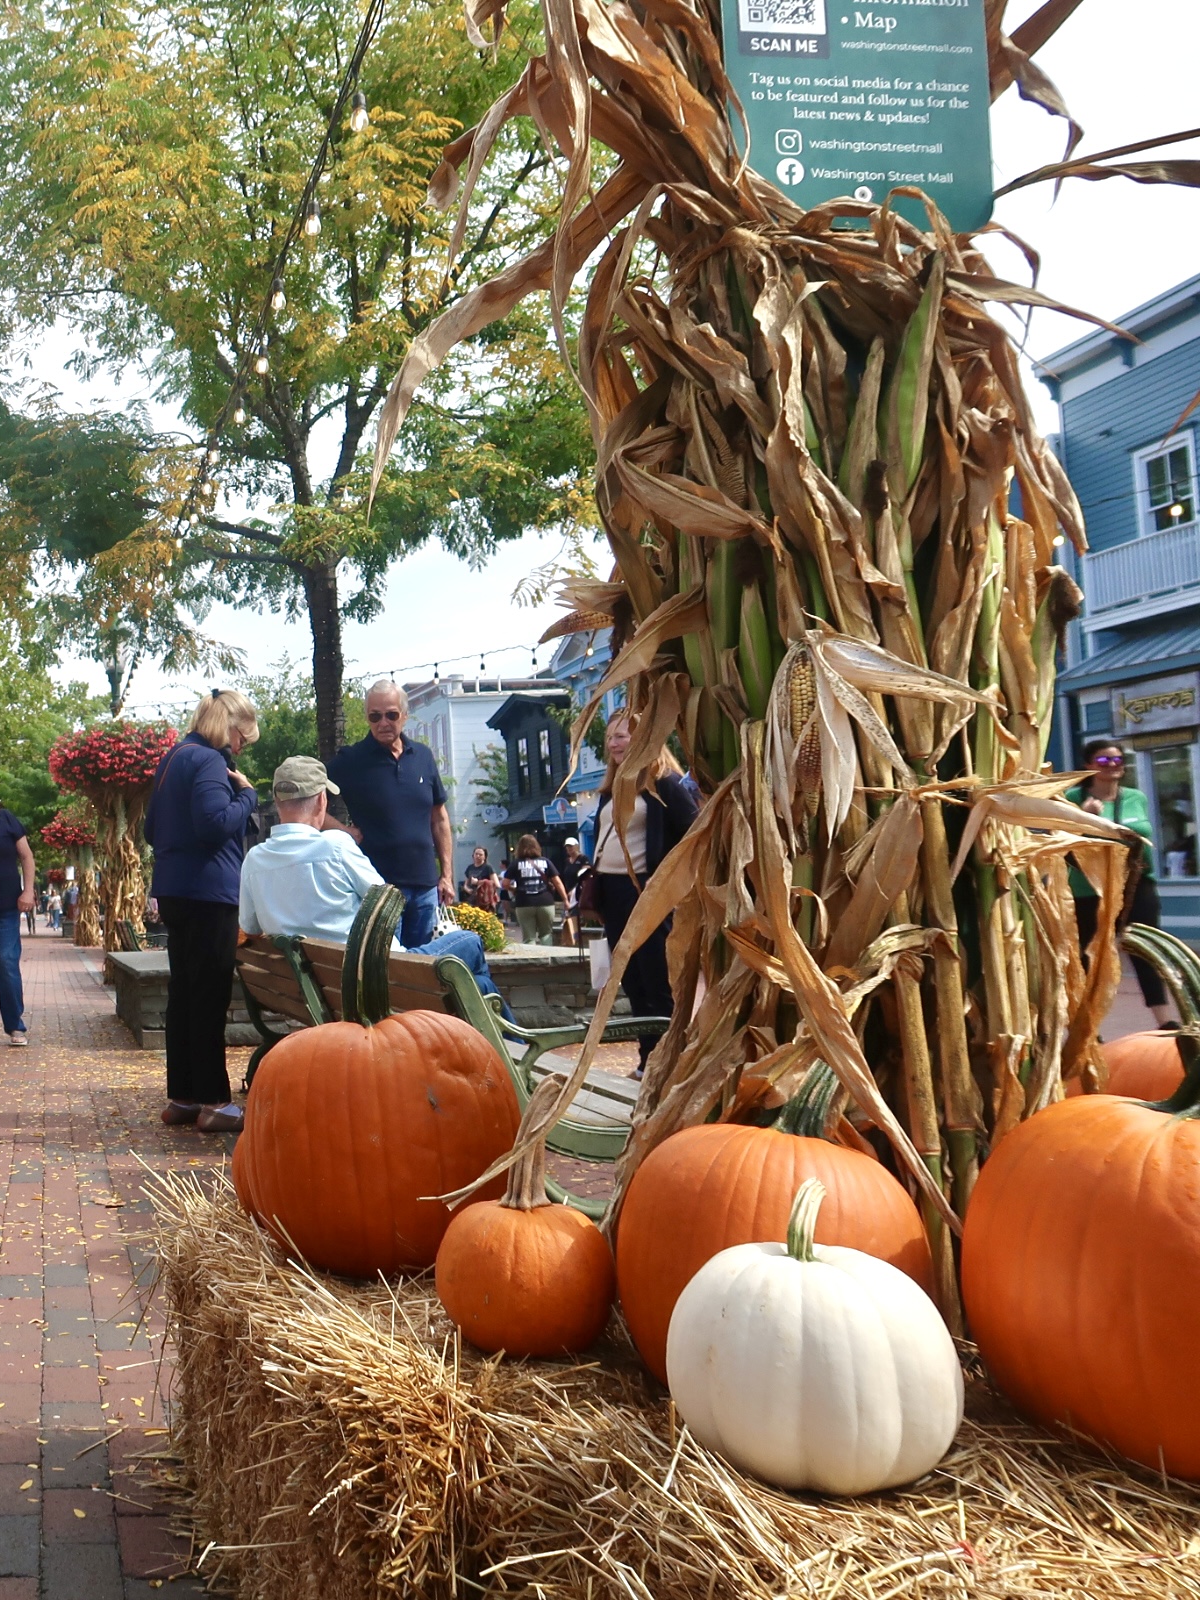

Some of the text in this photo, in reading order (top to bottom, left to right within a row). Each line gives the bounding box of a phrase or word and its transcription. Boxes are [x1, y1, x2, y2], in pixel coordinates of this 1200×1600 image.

[854, 11, 898, 33] Map
[750, 37, 818, 53] SCAN ME
[840, 40, 973, 54] washingtonstreetmall.com
[749, 72, 970, 93] Tag us on social media for a chance
[751, 89, 970, 109] to be featured and follow us for the
[793, 106, 930, 126] latest news & updates!
[809, 138, 943, 154] washingtonstreetmall
[811, 167, 954, 184] Washington Street Mall
